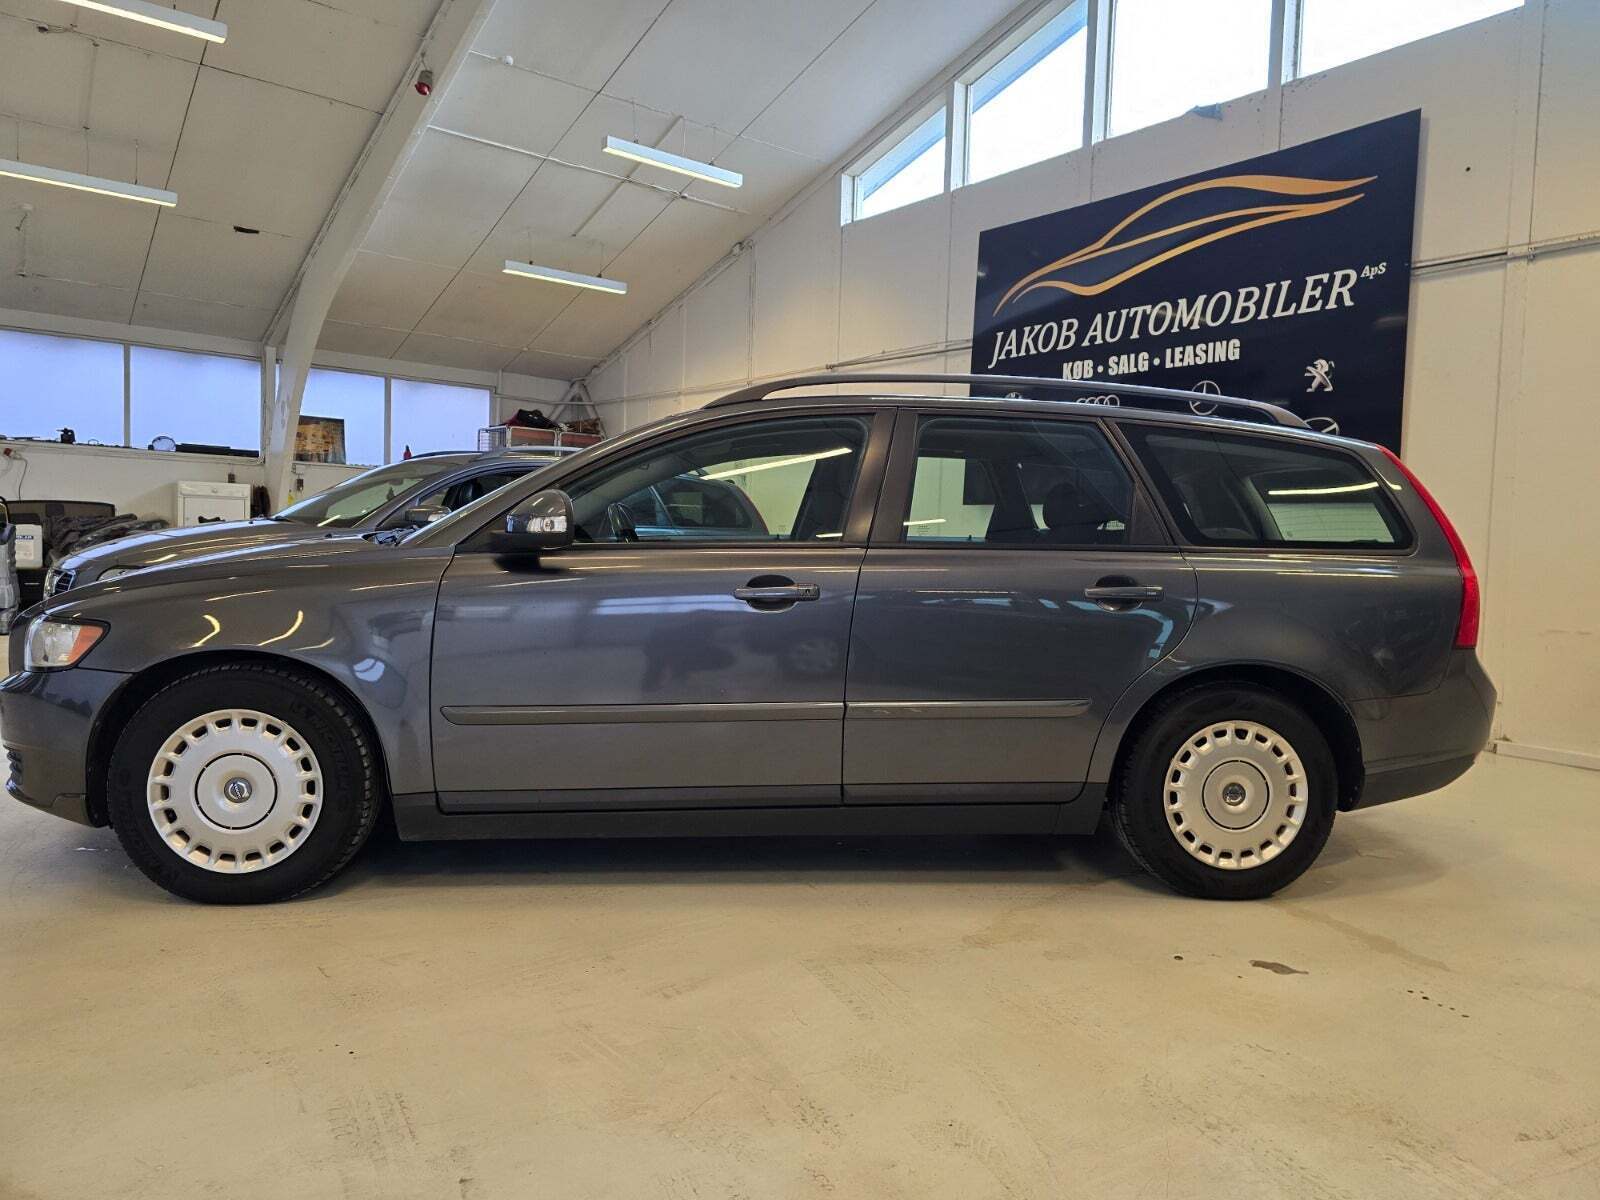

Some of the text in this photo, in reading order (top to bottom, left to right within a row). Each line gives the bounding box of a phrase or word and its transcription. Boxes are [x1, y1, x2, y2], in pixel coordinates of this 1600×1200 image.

[988, 262, 1387, 369] JAKOB AUTOMOBILER ApS
[1062, 339, 1241, 380] KØB SALG LEASING
